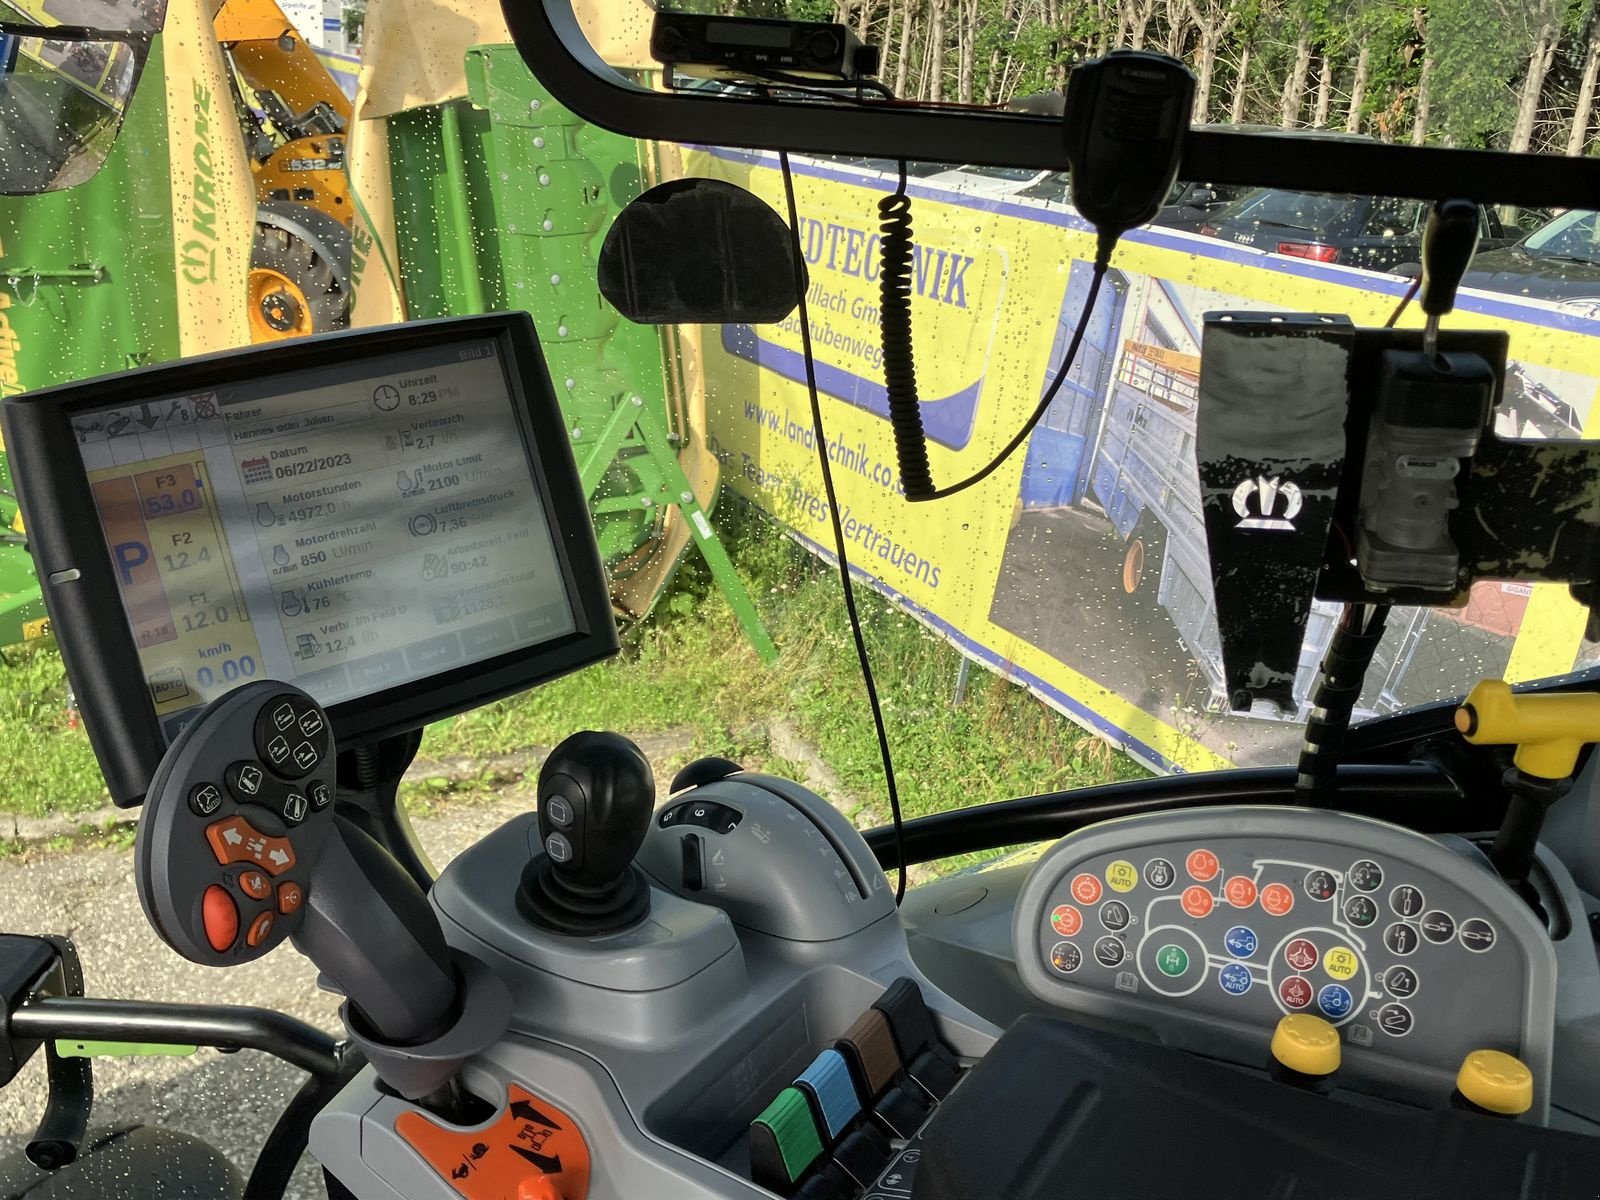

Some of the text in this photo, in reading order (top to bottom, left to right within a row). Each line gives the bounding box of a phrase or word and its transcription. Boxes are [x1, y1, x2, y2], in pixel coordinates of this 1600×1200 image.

[192, 77, 217, 241] KRONE
[798, 216, 974, 309] DTECNIK
[806, 282, 882, 326] illach Gm
[776, 316, 884, 370] adtubenweg
[398, 373, 439, 389] Uhrzeit
[407, 390, 437, 406] 8:29
[224, 408, 262, 422] Fahrer
[410, 412, 465, 431] Verbrauch
[234, 426, 275, 440] Hannes
[275, 420, 300, 433] oder
[416, 434, 436, 450] 2,7
[743, 399, 906, 496] www.landchnik.co.
[269, 445, 308, 460] Datum
[274, 453, 352, 479] 06/22/2023
[423, 453, 483, 474] Motor Limit
[155, 474, 177, 489] F3
[427, 474, 460, 491] 2100
[147, 489, 195, 514] 53.0
[282, 480, 362, 505] Motorstunden
[434, 489, 517, 515] Luftbremsdruck
[788, 480, 829, 522] hres
[288, 502, 336, 522] 4972,0
[295, 521, 377, 548] Motordrehzahl
[439, 517, 468, 533] 7,36
[172, 532, 193, 547] F2
[114, 541, 149, 586] P
[164, 546, 211, 572] 12.4
[301, 541, 374, 567] 850 U/min
[450, 555, 488, 575] 90:42
[189, 592, 208, 607] F1
[312, 596, 331, 611] 76
[182, 606, 228, 632] 12.0
[198, 642, 232, 659] km/h
[325, 636, 357, 654] 12,4
[196, 655, 257, 689] 0.00
[155, 679, 184, 694] AUTO
[1110, 877, 1132, 888] AUTO
[1329, 964, 1352, 975] AUTO
[1225, 981, 1245, 992] AUTO
[1286, 995, 1304, 1005] AUTO
